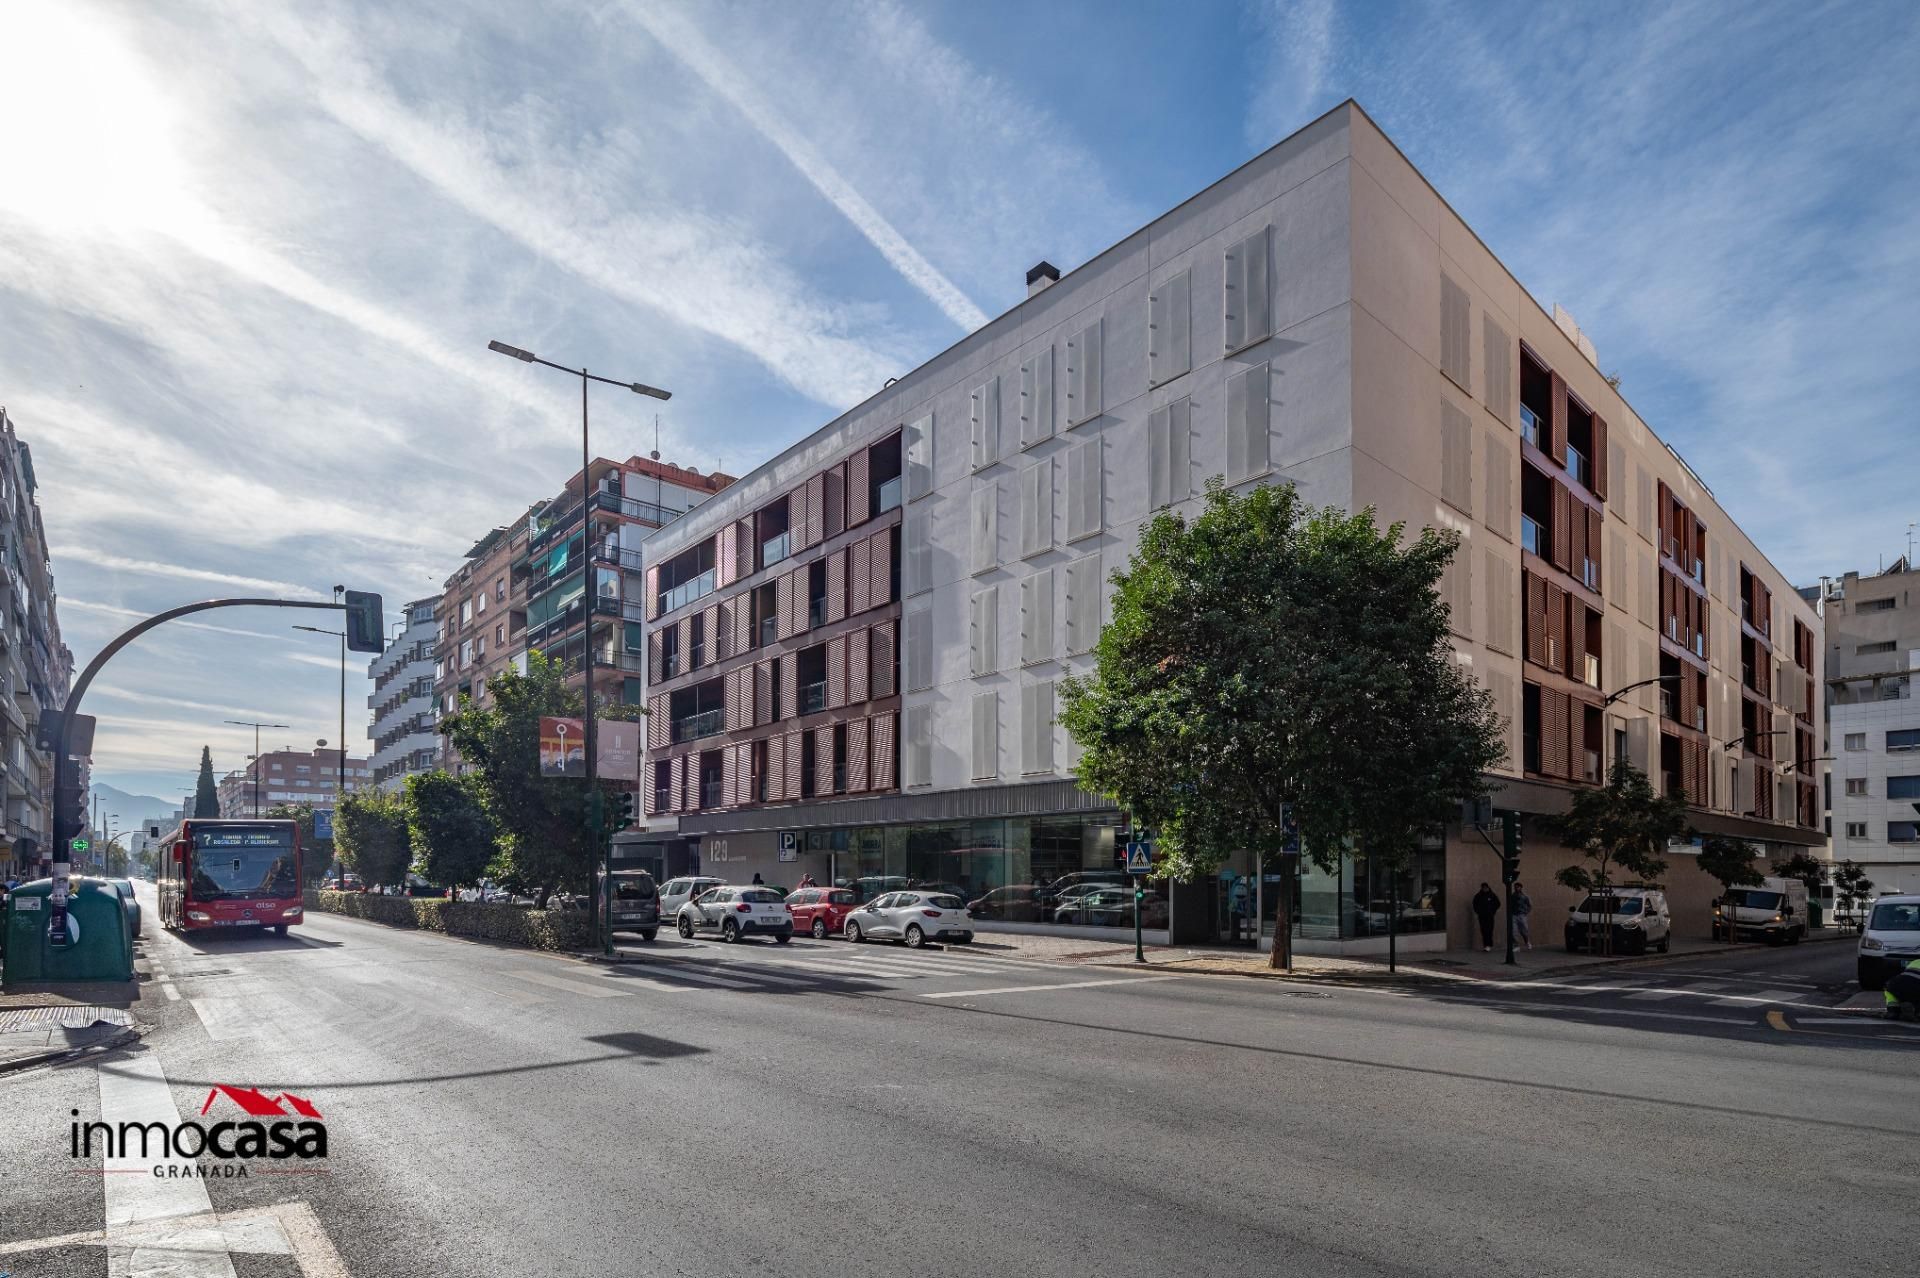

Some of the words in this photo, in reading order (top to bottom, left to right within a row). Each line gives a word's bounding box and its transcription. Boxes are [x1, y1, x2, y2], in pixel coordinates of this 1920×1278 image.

[203, 834, 211, 845] 7
[784, 834, 794, 849] P
[710, 839, 728, 862] 129
